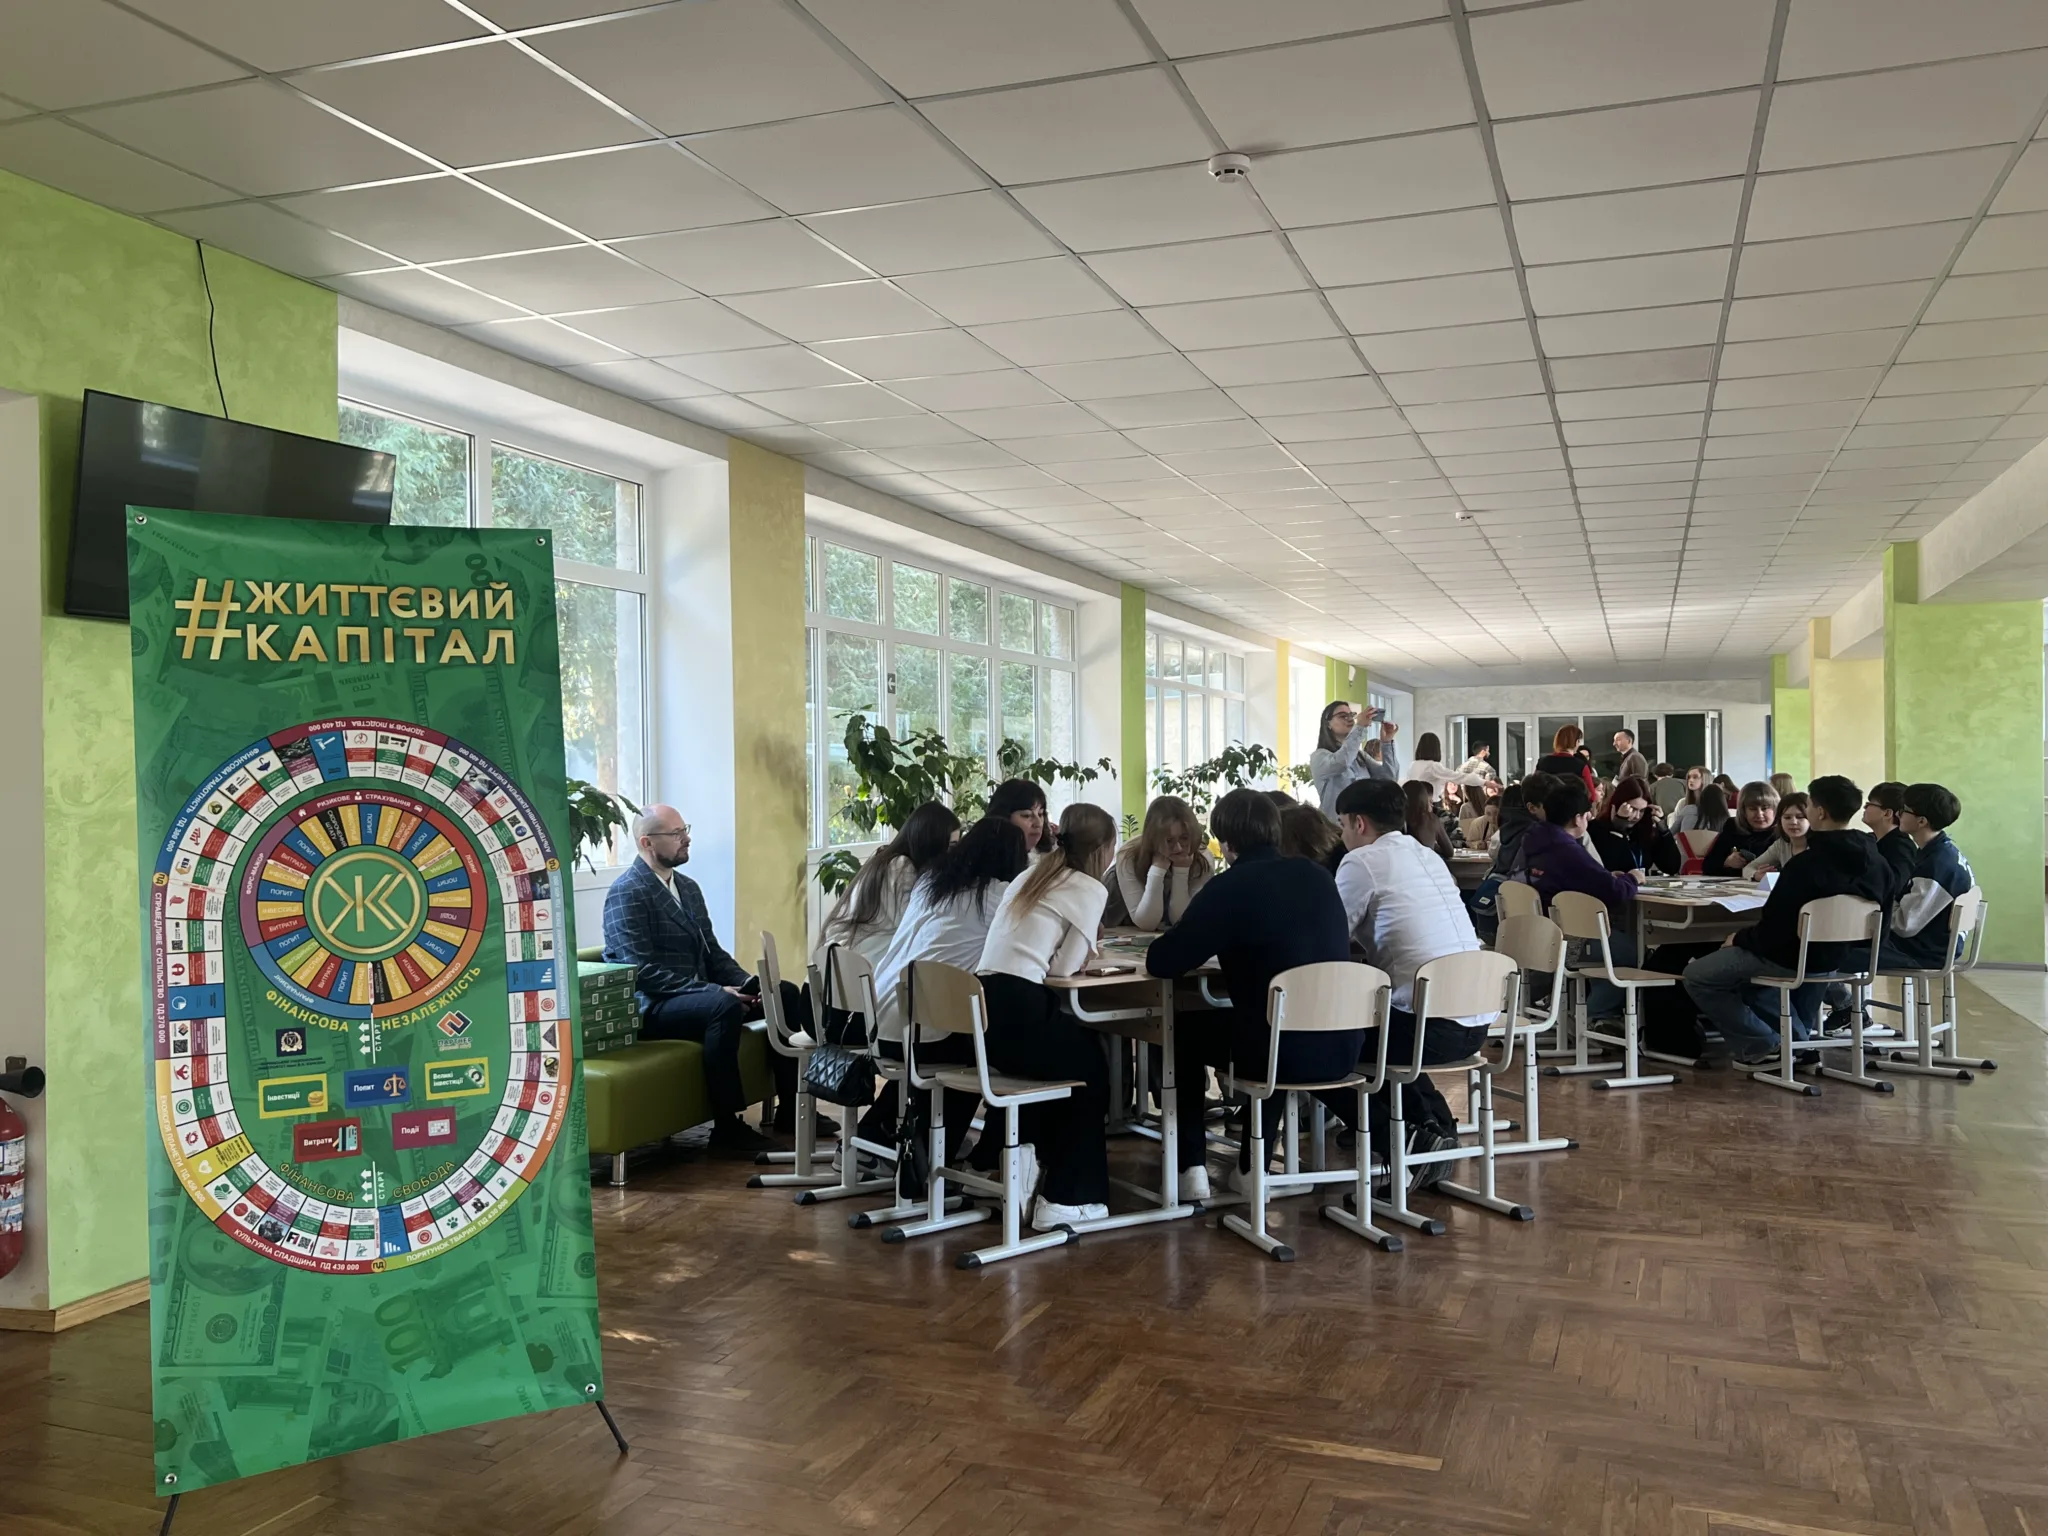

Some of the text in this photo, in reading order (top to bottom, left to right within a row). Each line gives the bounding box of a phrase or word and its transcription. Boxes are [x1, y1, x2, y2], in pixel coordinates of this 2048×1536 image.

[246, 623, 515, 664] КАПІТАЛ
[351, 720, 389, 729] ЛЮДСТВА
[222, 748, 260, 775] ФІНАНСОВА
[186, 776, 223, 814] ГРАМОТНІСТЬ
[317, 794, 411, 808] РИЗИКОВЕ СТРАХУВАННЯ
[506, 784, 527, 810] ДЖЕРЕЛА
[527, 809, 551, 853] АЛЬТЕРНАТИВНІ
[295, 838, 316, 857] ПОПИТ
[246, 852, 264, 895] ФОРС-МАЖОР
[280, 852, 307, 870] ВИТРАТИ
[270, 887, 293, 896] ПОПИТ
[155, 892, 163, 945] СПРАВЕДЛИВЕ
[268, 919, 298, 933] ВИТРАТИ
[277, 933, 300, 948] ПОПИТ
[156, 947, 164, 998] СУСПІЛЬСТВО
[317, 962, 335, 988] ВИТРАТИ
[337, 970, 348, 992] ПОПИТ
[424, 962, 461, 996] СПАДКУВАННЯ
[266, 990, 349, 1032] ФІНАНСОВА
[381, 967, 481, 1031] НЕЗАЛЕЖНІСТЬ
[274, 975, 315, 1004] ФРАНЧАЙЗИНГ
[157, 1003, 165, 1014] ПД
[374, 1023, 382, 1051] СТАРТ
[438, 1037, 473, 1046] ПАРТНЕР
[267, 1091, 300, 1102] Інвестиції
[354, 1083, 375, 1092] Попит
[303, 1136, 333, 1147] Витрати
[401, 1126, 419, 1135] Події
[280, 1163, 355, 1202] ФІНАНСОВА
[393, 1161, 455, 1198] СВОБОДА
[234, 1228, 273, 1256] КУЛЬТУРНА
[274, 1251, 316, 1268] СПАДЩИНА
[320, 1262, 331, 1272] ПД
[406, 1241, 449, 1262] ПОРЯТУНОК
[449, 1226, 477, 1245] ТВАРИН
[477, 1217, 489, 1227] ПД
[372, 1261, 384, 1270] ПД
